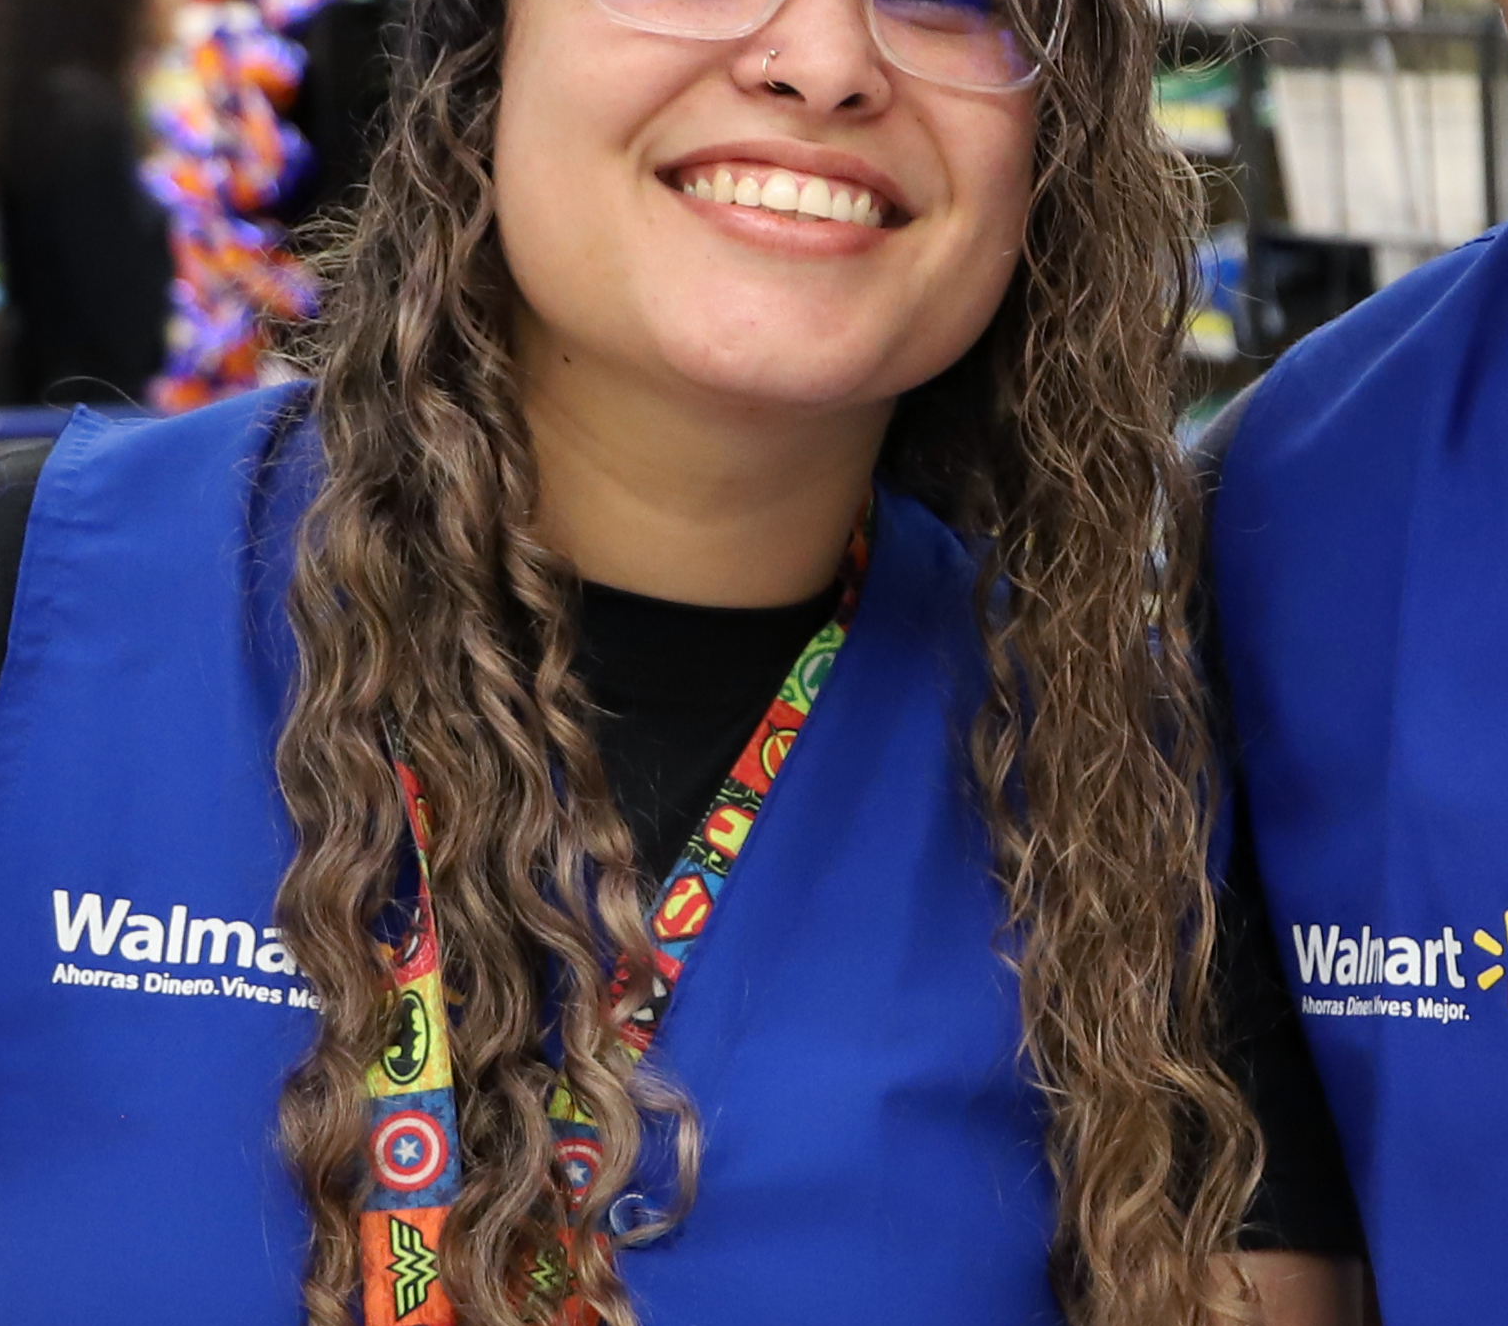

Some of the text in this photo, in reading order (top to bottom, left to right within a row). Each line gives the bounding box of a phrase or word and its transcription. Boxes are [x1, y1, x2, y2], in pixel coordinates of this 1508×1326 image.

[52, 888, 308, 978] Walma
[52, 962, 140, 991] Ahorras
[1302, 994, 1345, 1016] Ahorras
[1417, 996, 1472, 1025] Mejor.
